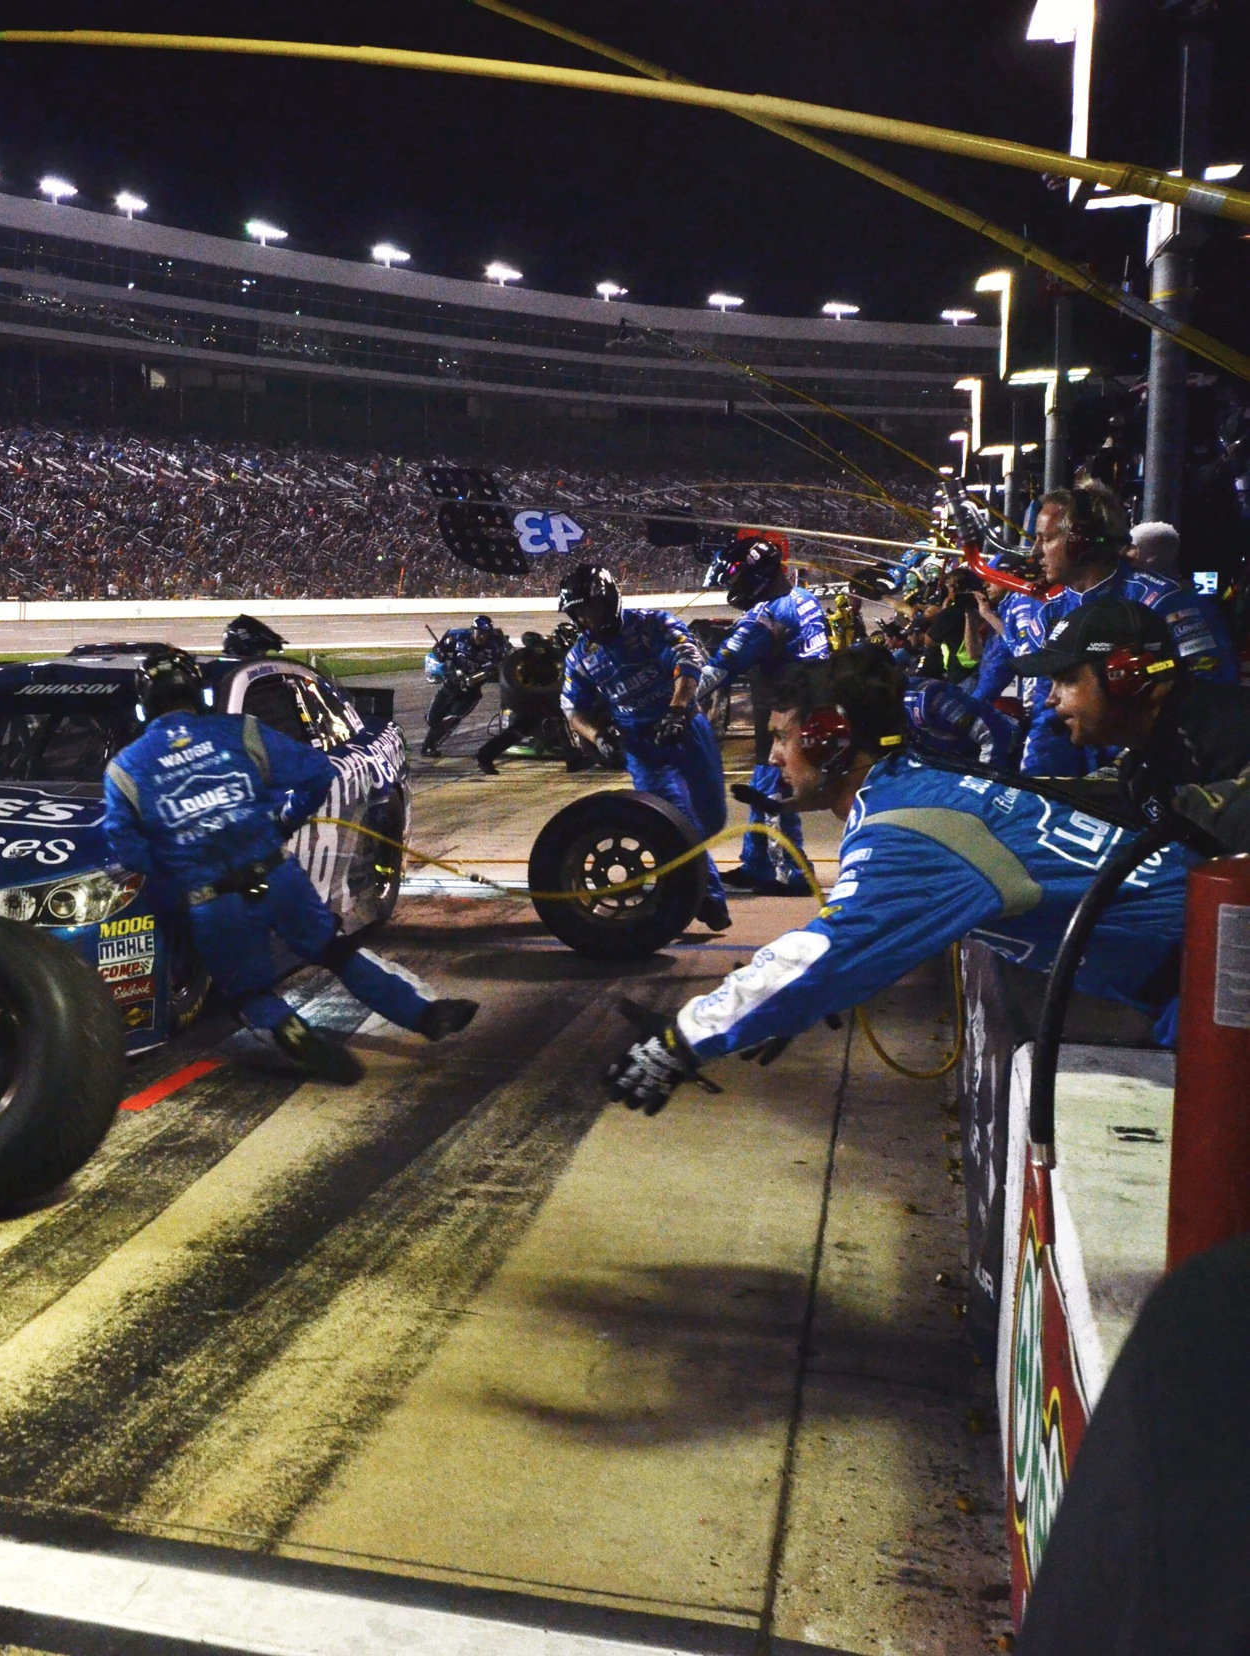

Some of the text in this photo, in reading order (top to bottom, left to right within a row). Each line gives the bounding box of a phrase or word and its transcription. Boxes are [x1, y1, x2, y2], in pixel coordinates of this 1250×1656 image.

[14, 683, 121, 696] JOHNSON
[157, 741, 215, 768] WAUGH
[99, 915, 155, 939] MOOG
[100, 935, 153, 960] MAHLE
[101, 963, 140, 980] COMP
